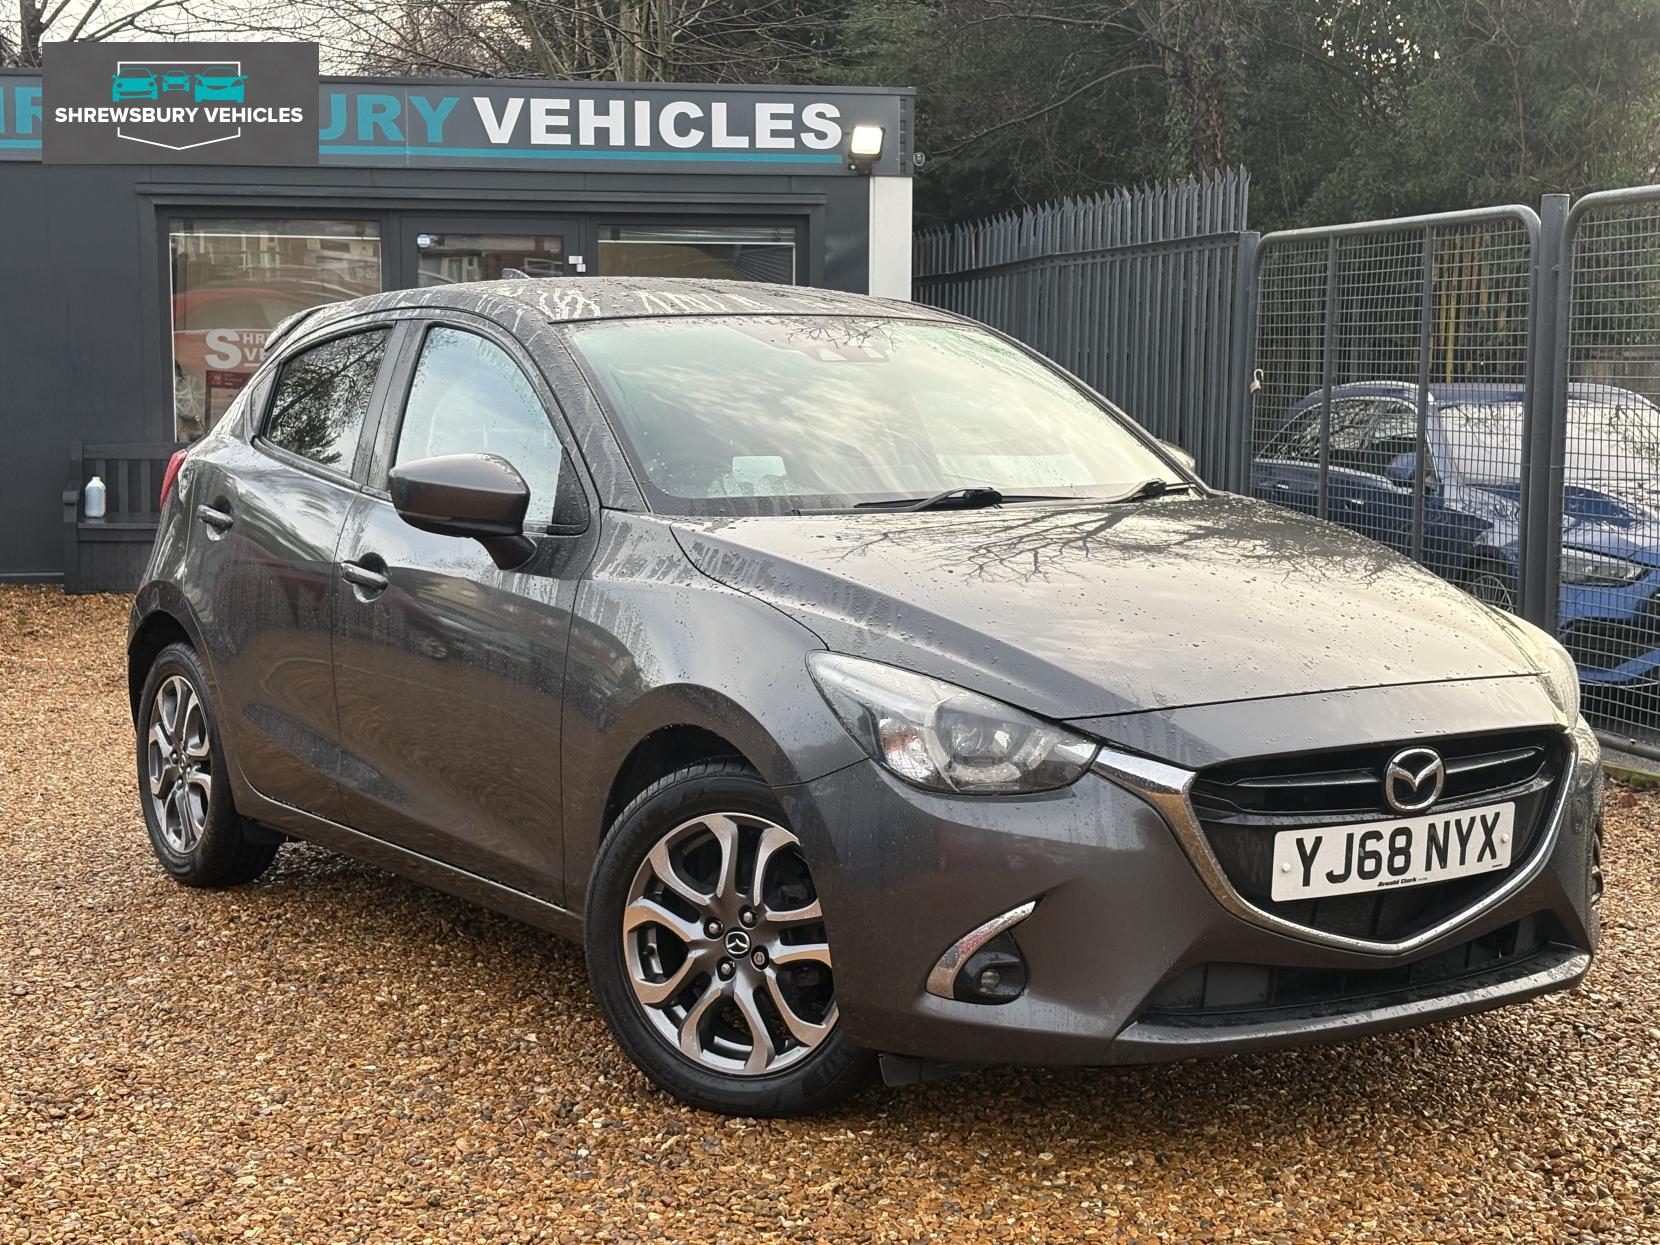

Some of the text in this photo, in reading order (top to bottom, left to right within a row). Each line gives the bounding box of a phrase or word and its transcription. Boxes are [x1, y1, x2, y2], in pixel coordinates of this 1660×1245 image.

[472, 97, 843, 150] VEHICLES
[1295, 811, 1501, 887] YJ68 NYX
